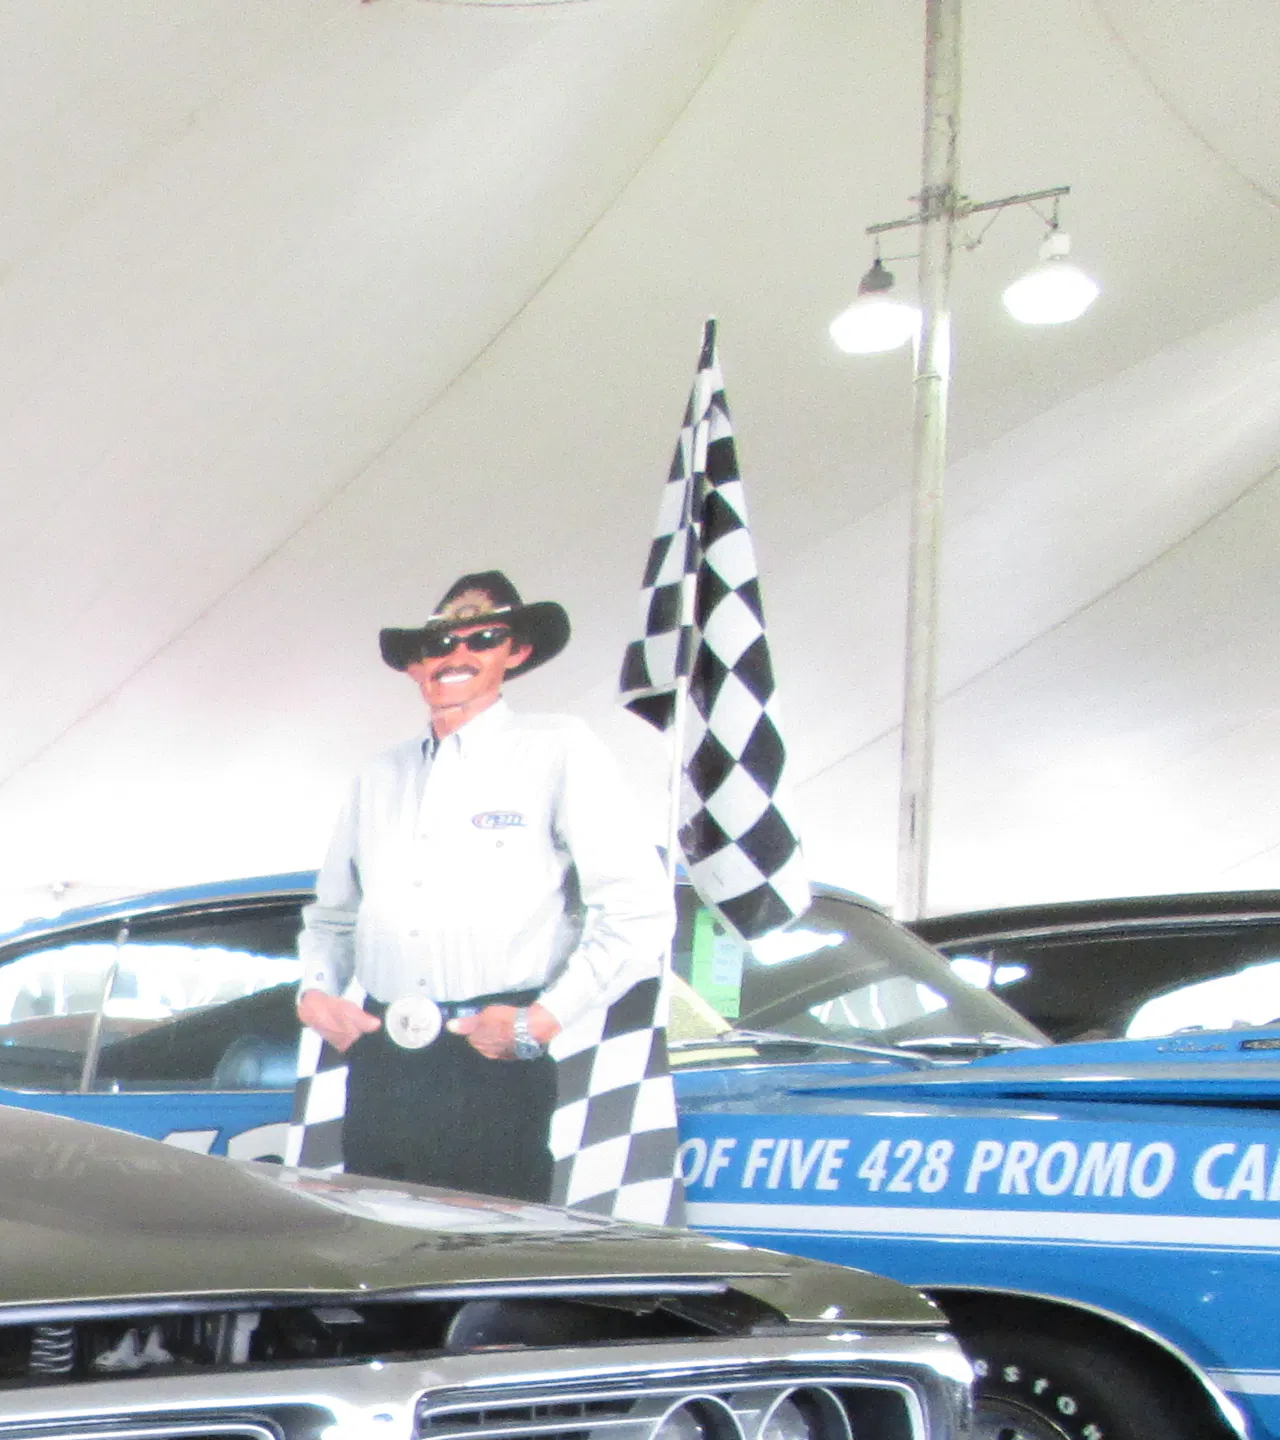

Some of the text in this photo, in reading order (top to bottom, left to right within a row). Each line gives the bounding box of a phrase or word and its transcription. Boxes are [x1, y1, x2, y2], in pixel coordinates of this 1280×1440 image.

[673, 1137, 1280, 1202] OF FIVE 428 PROMO CA
